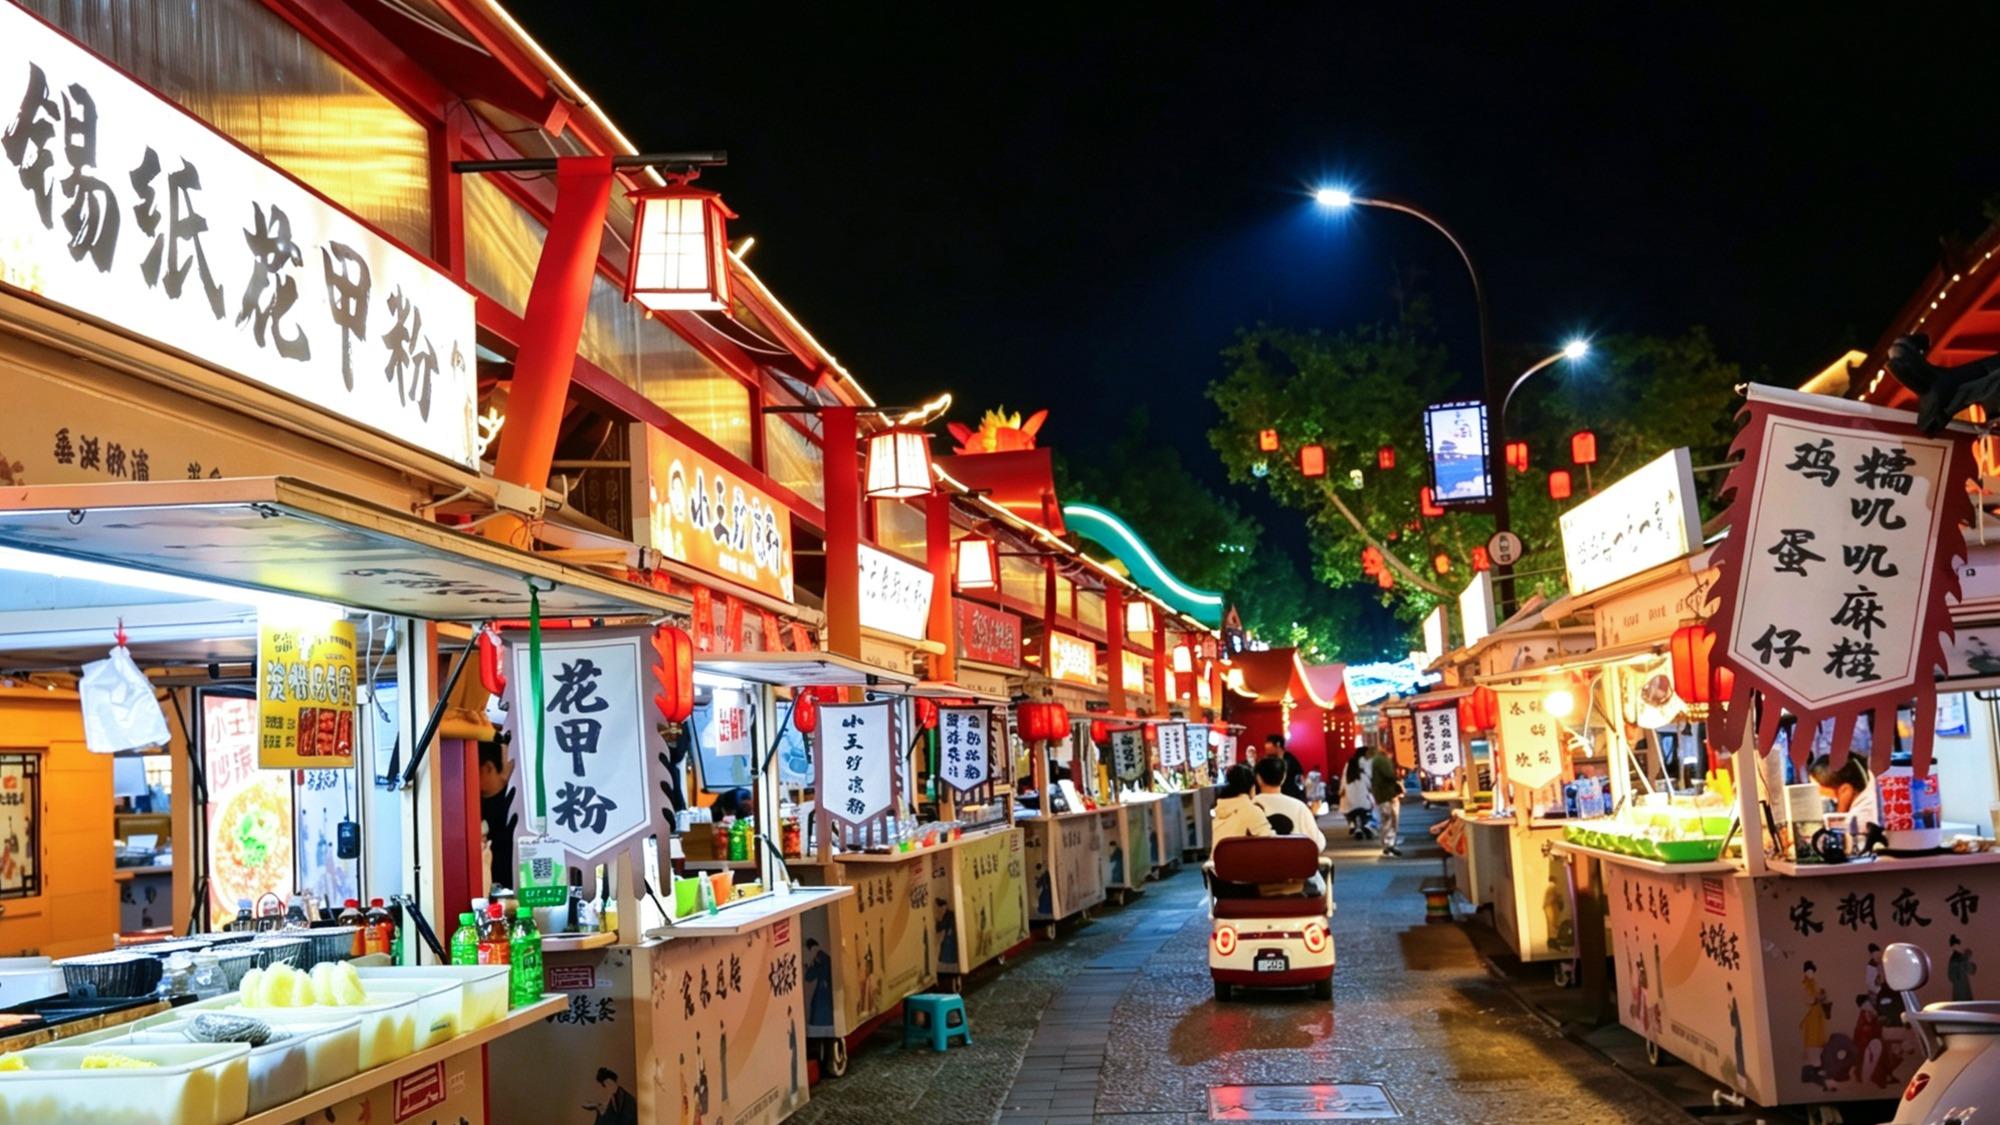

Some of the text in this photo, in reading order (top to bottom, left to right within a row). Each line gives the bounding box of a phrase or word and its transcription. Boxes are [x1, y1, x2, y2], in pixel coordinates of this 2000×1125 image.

[1, 60, 440, 423] 锡纸花甲粉
[1750, 437, 1842, 670] 鸡蛋仔
[546, 658, 618, 835] 花甲粉
